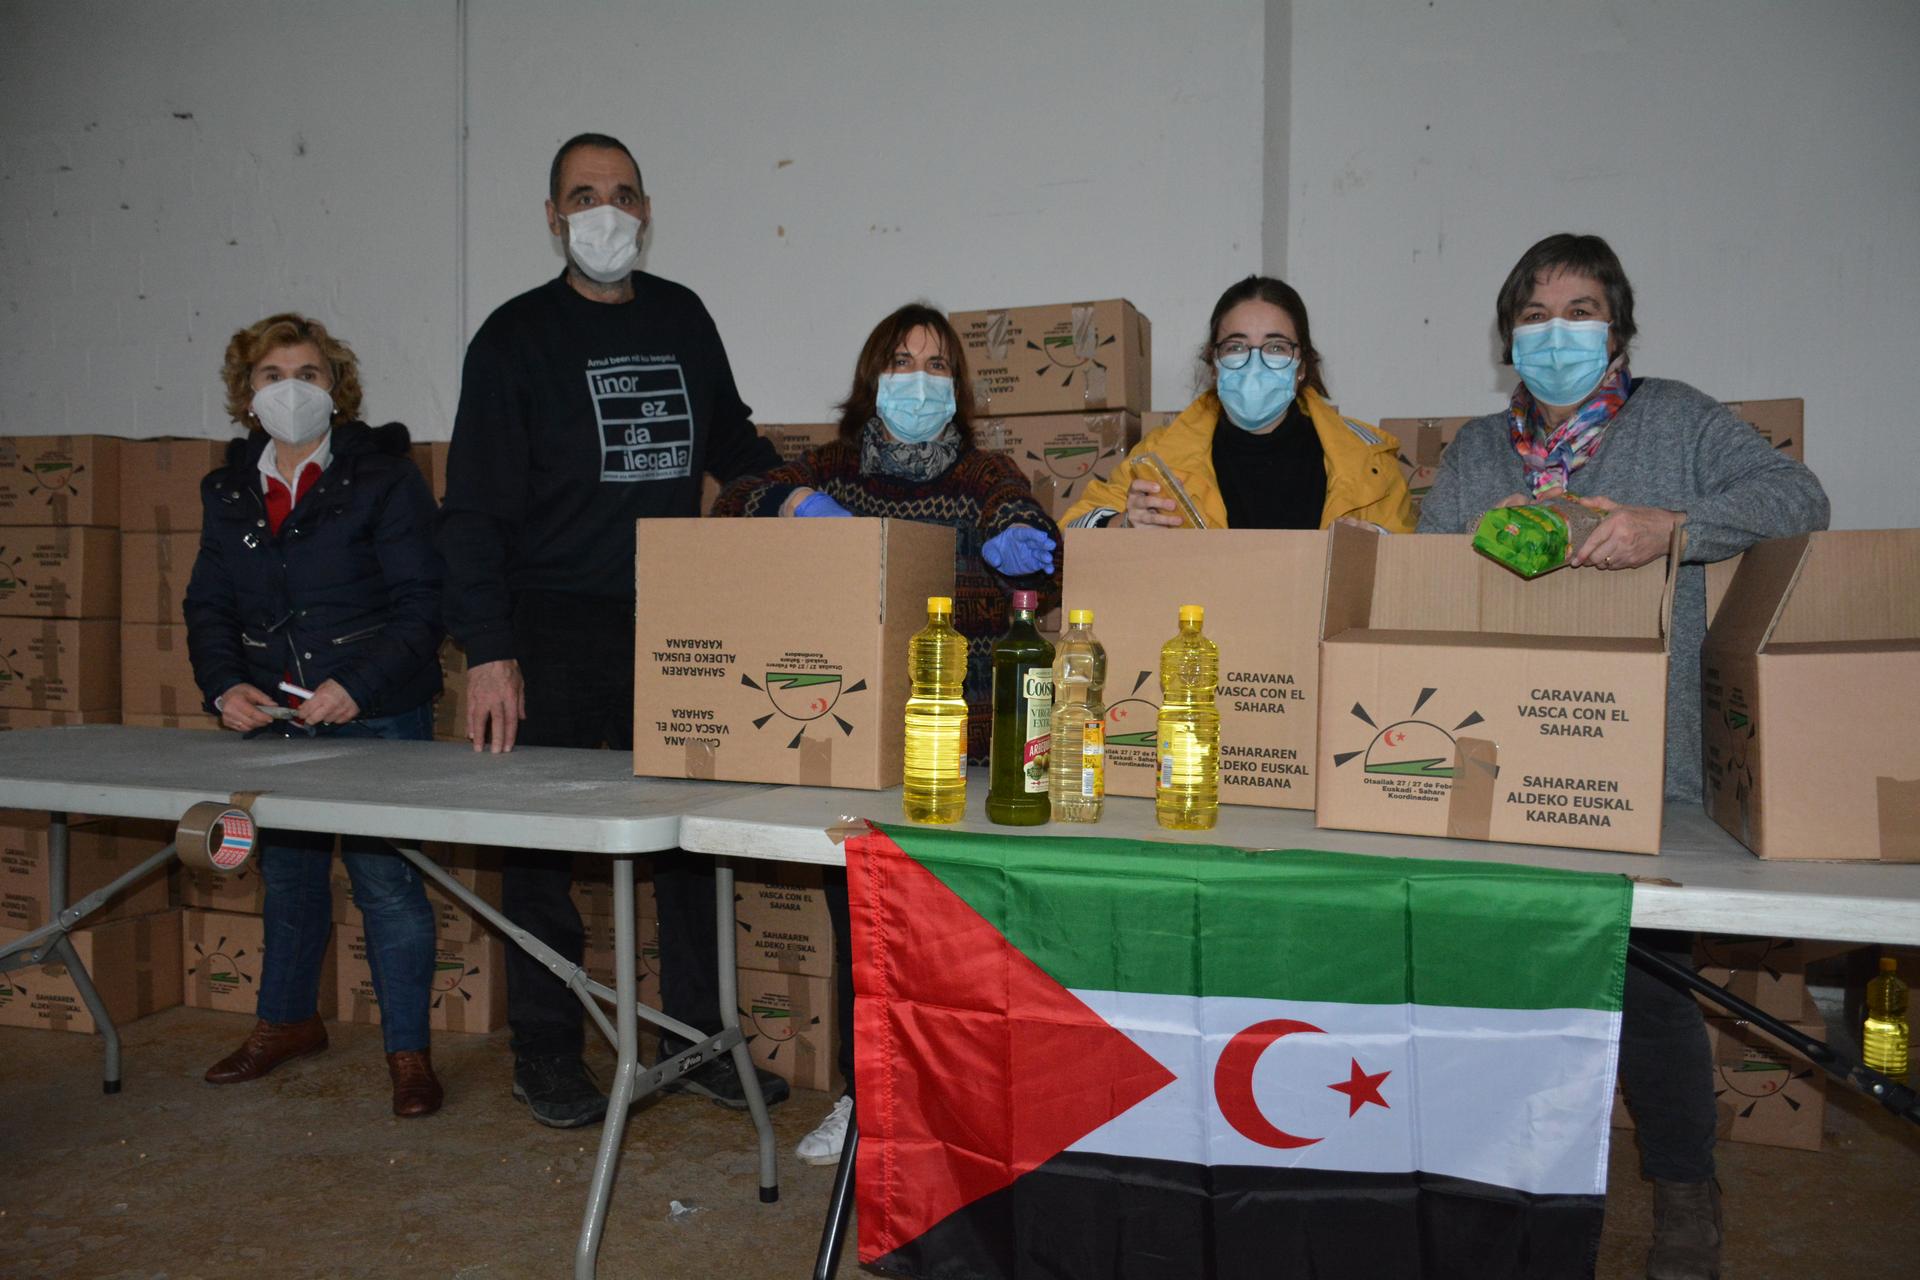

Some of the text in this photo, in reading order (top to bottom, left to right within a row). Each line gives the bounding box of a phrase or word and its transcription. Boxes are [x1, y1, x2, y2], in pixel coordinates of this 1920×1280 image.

[595, 375, 639, 394] inor
[640, 400, 668, 417] ez
[624, 423, 651, 445] da
[622, 446, 688, 471] ilegala
[666, 638, 723, 649] KARABANA
[652, 651, 736, 664] ALDEKO EUSKAL
[662, 665, 725, 677] SAHARAREN
[1226, 671, 1295, 685] CARAVANA
[1215, 685, 1306, 700] VASCA CON EL
[1530, 688, 1616, 704] CARAVANA
[671, 708, 714, 719] SAHARA
[1234, 701, 1286, 714] SAHARA
[1517, 704, 1629, 722] VASCA CON EL
[655, 721, 729, 734] VASCA CON EL
[1539, 723, 1604, 738] SAHARA
[1138, 755, 1157, 763] Sahar
[1221, 745, 1298, 760] SAHARAREN
[1217, 760, 1309, 776] LDEKO EUSKAL
[1223, 775, 1292, 789] KARABANA
[1363, 777, 1394, 786] Otsailak
[1522, 775, 1618, 793] SAHARAREN
[1382, 785, 1412, 793] Euskadi
[1418, 788, 1446, 796] Sahara
[1387, 792, 1439, 802] Koordinadora
[1507, 792, 1634, 812] ALDEKO EUSKAL
[1526, 809, 1611, 828] KARABANA
[787, 942, 816, 953] ESKAL
